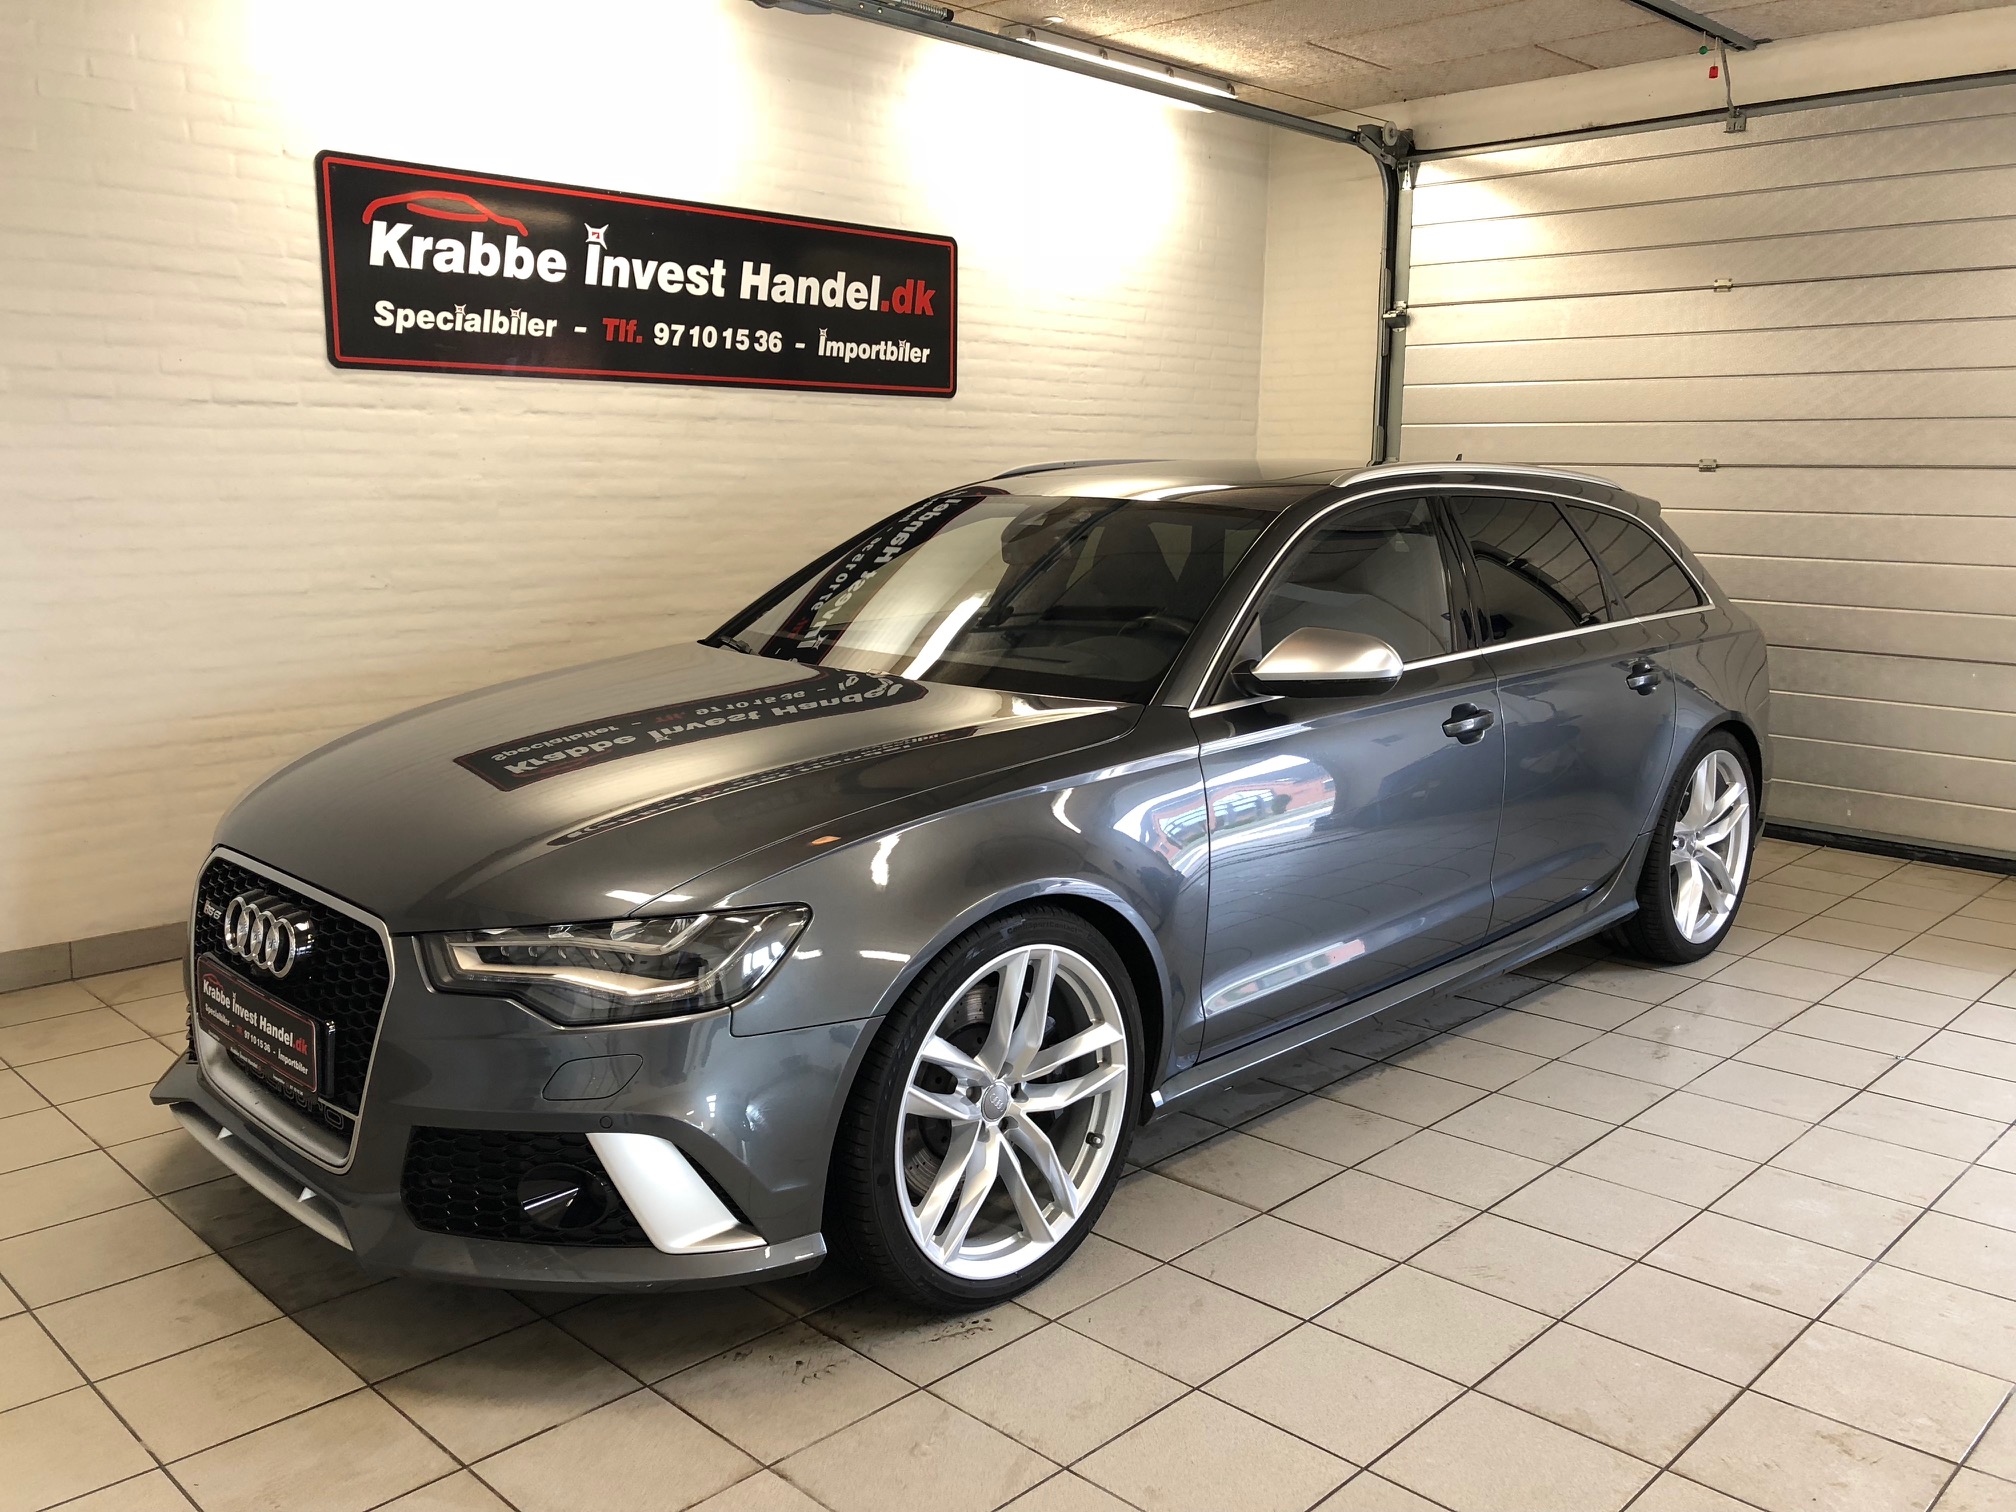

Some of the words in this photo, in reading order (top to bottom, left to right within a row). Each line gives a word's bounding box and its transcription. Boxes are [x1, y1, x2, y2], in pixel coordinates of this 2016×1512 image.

[369, 220, 567, 283] Krabbe
[584, 223, 726, 298] Invest
[740, 260, 936, 316] Handel.dk
[373, 300, 557, 337] Specialbiler
[602, 318, 643, 343] Tlf.
[818, 328, 930, 363] Importbiler
[203, 979, 231, 1009] Krabbe
[259, 1015, 308, 1055] Handel.dk
